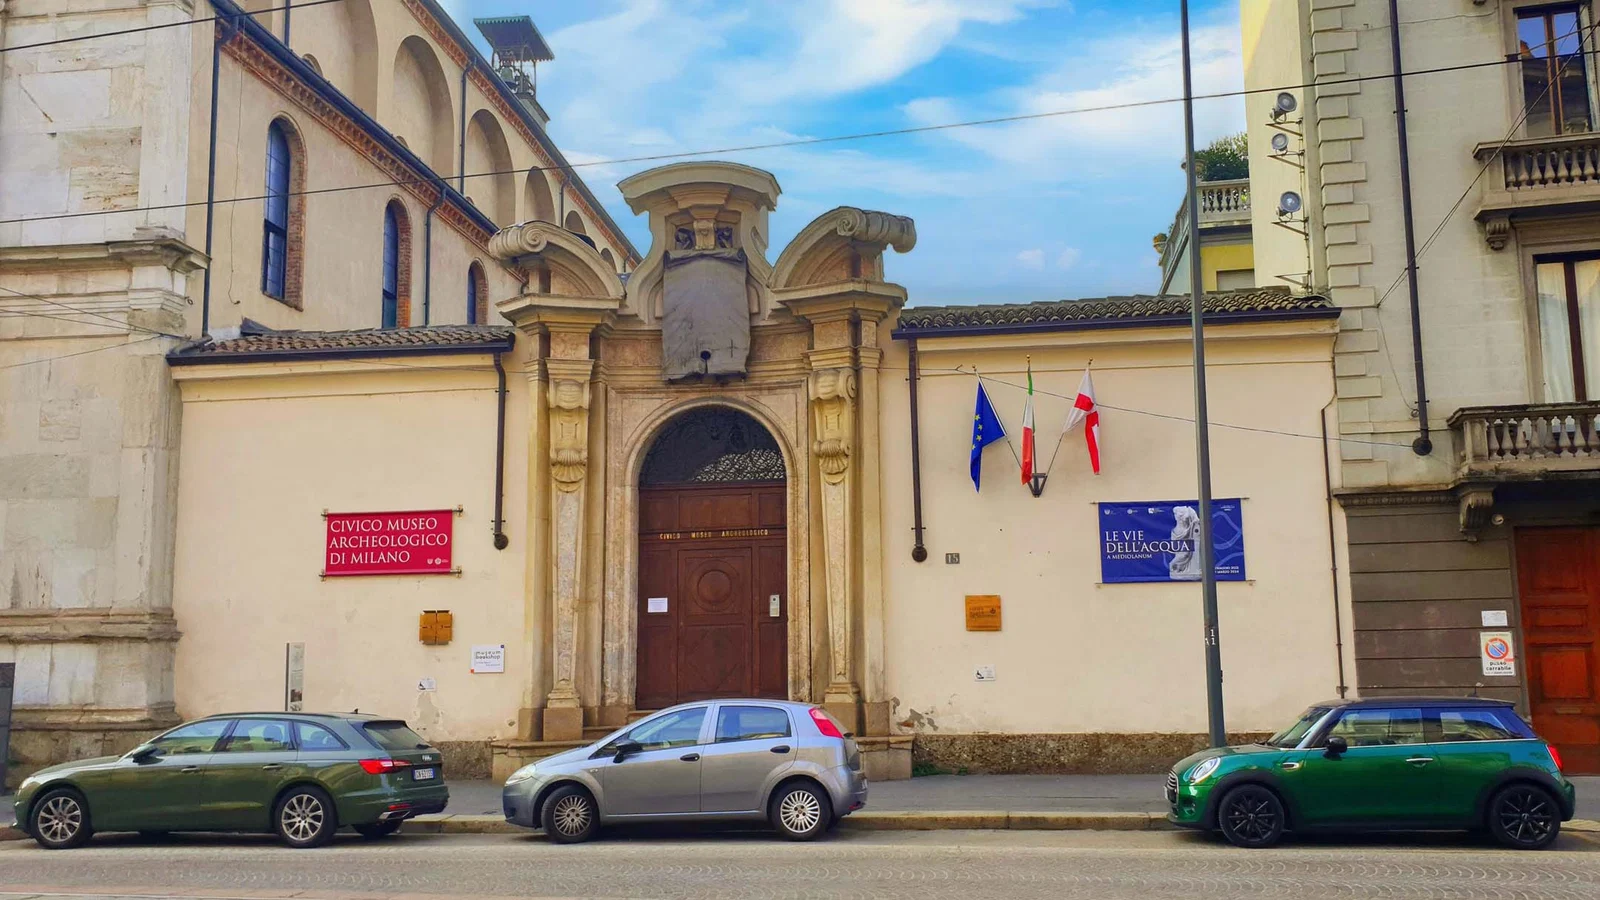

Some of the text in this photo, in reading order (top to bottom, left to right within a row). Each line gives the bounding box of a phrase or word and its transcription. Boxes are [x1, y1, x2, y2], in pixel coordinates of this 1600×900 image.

[330, 517, 438, 533] CIVICO MUSEO
[329, 533, 448, 549] ARCHEOLOGICO
[1105, 530, 1144, 542] LE VIE
[1106, 541, 1190, 554] DELL'ACQUA
[330, 550, 411, 565] DI MILANO
[947, 554, 959, 563] 15
